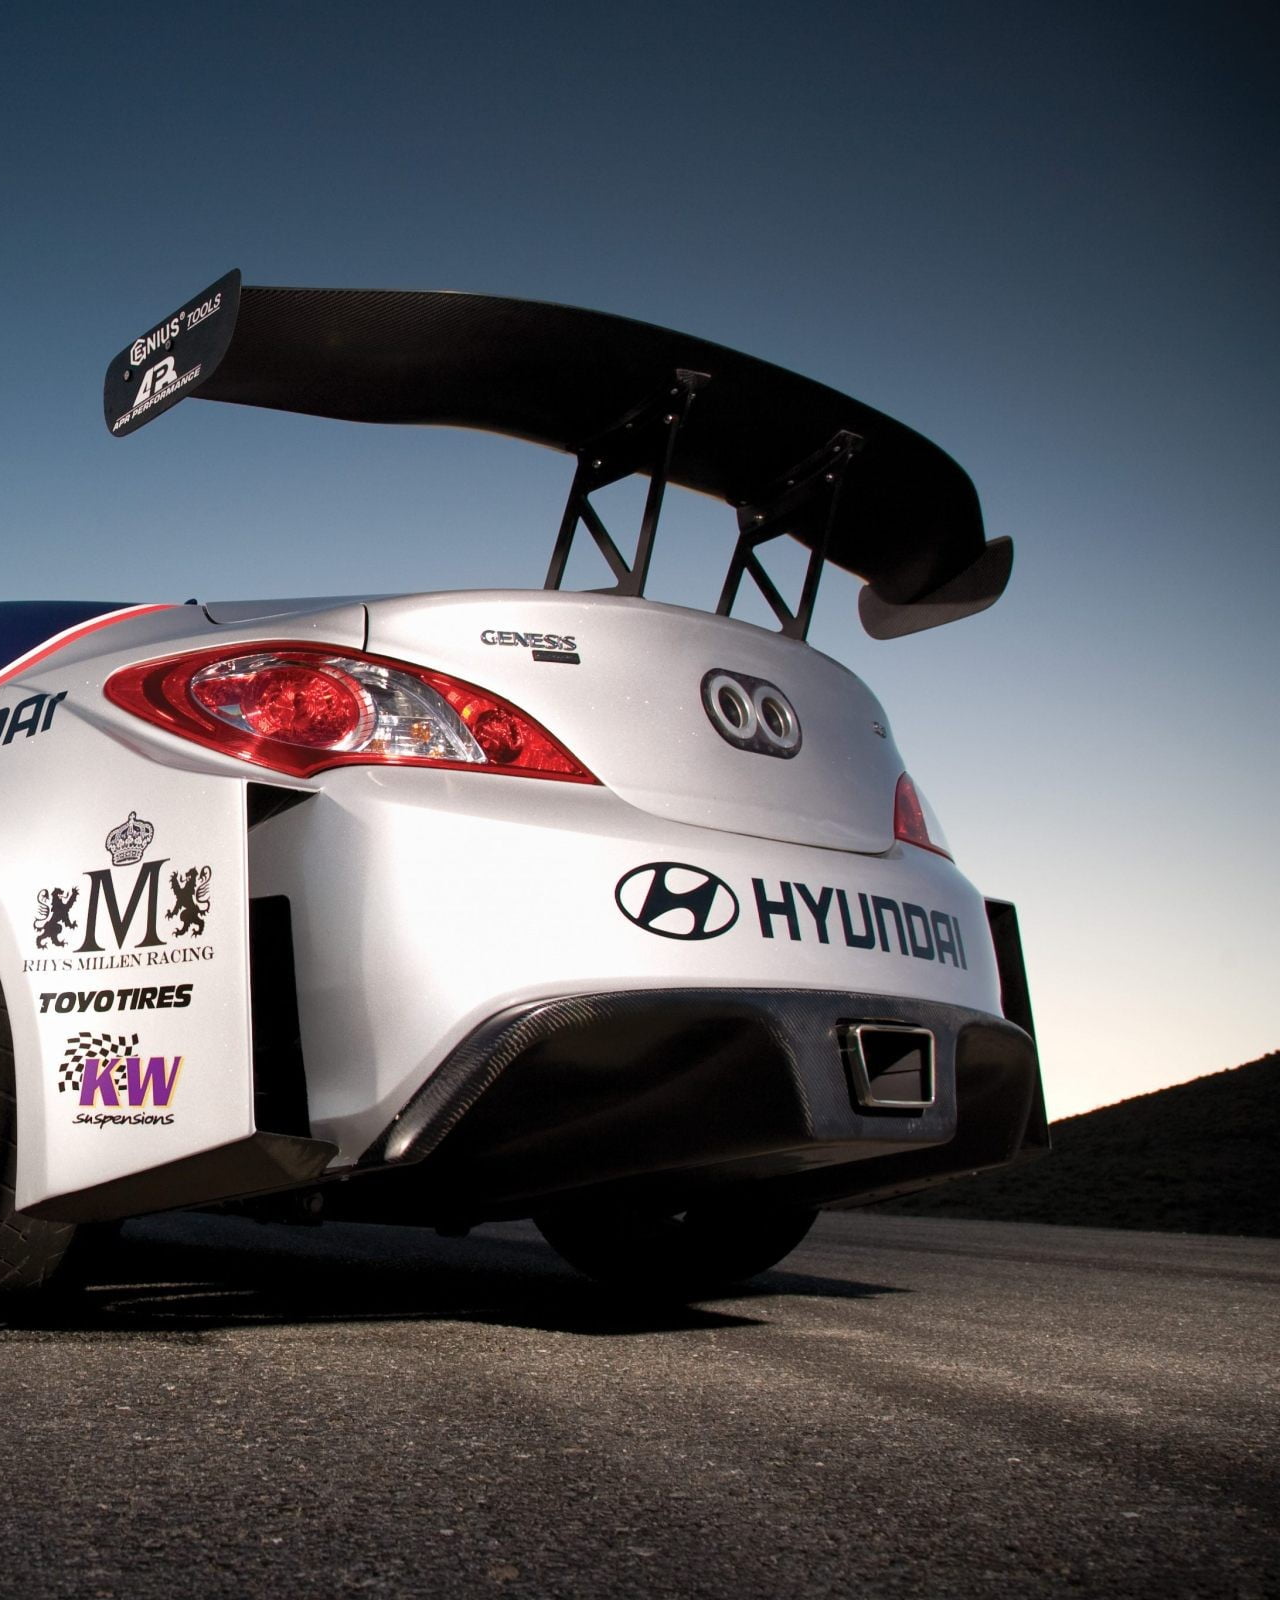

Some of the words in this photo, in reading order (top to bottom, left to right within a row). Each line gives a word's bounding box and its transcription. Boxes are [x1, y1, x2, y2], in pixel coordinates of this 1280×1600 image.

[187, 293, 222, 327] TOOLS
[113, 415, 131, 432] APR
[131, 367, 201, 420] PERFORMANCE
[480, 629, 577, 651] GENESIS
[73, 858, 170, 953] M
[751, 877, 968, 970] HYUNDAI
[23, 959, 72, 973] RHYS
[77, 953, 142, 971] MILLEN
[147, 946, 215, 966] RACING
[39, 989, 115, 1014] TOYO
[116, 984, 194, 1011] TIRES
[78, 1055, 184, 1108] KW
[72, 1112, 175, 1129] suspensions
